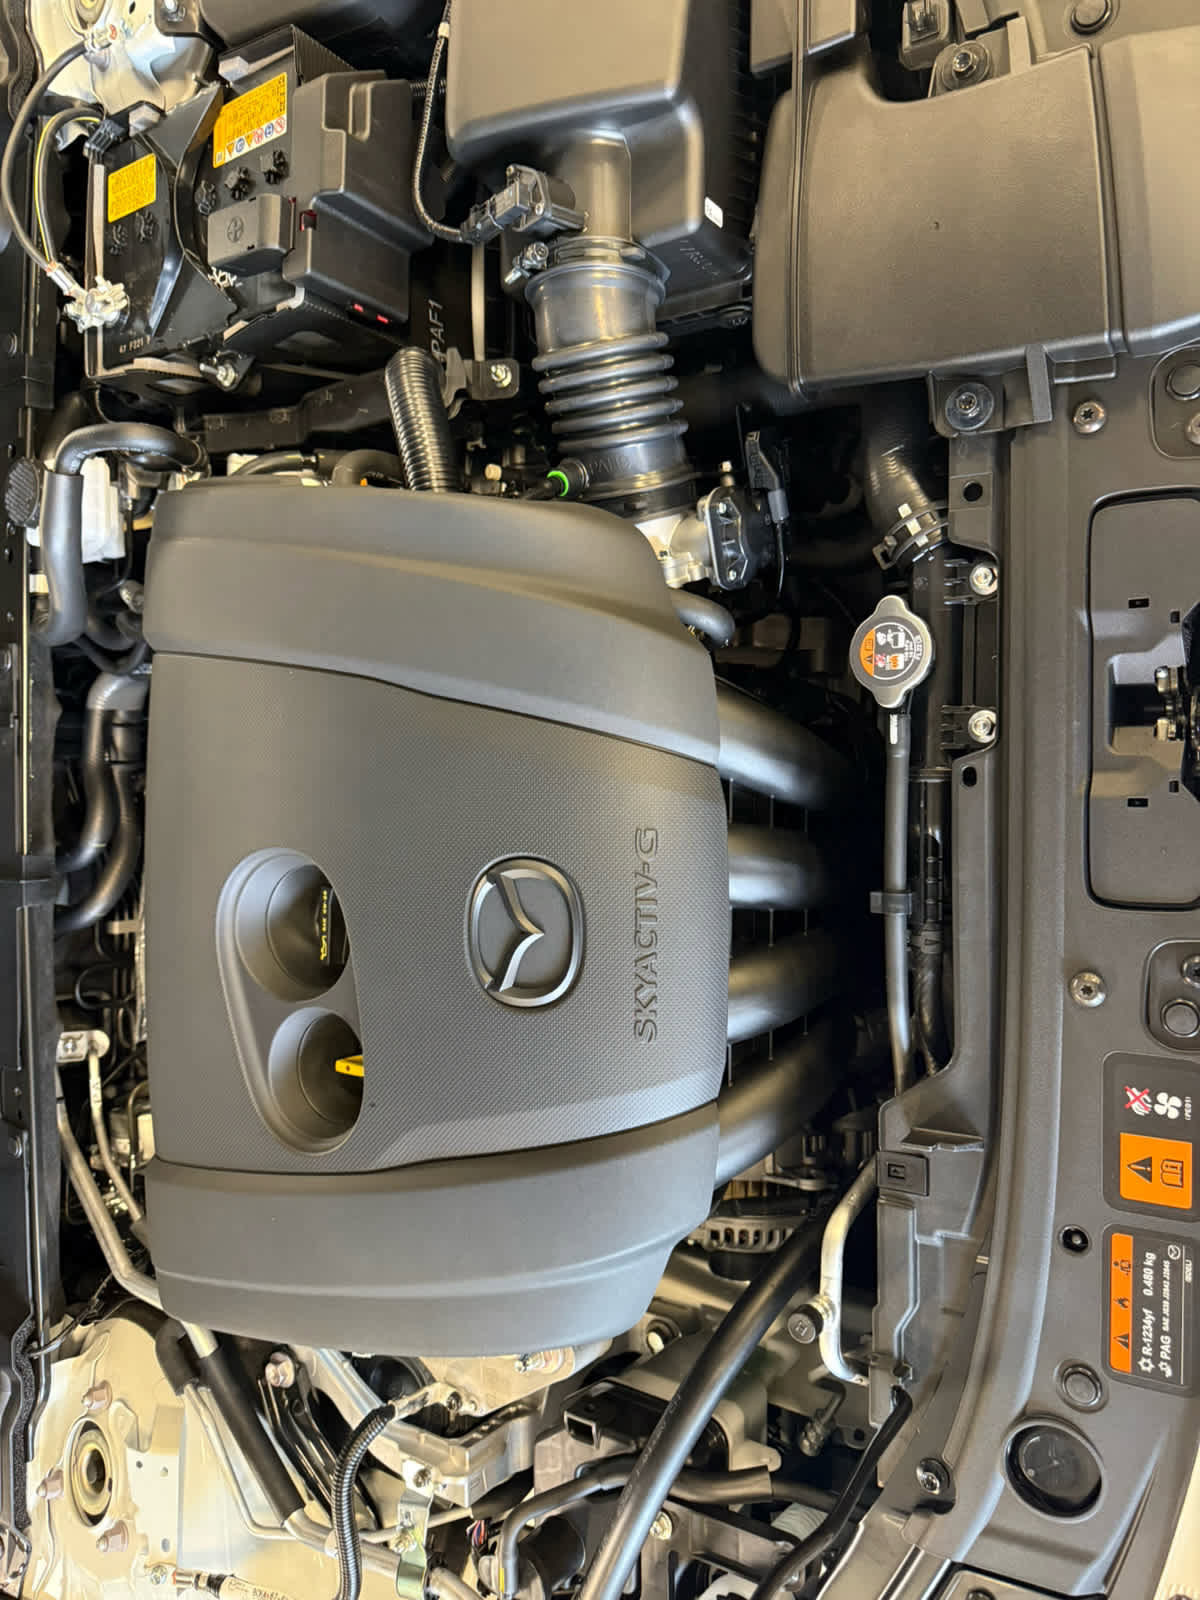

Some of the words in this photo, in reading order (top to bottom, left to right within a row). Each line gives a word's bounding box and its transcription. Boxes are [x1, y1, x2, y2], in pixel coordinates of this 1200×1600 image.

[633, 828, 659, 1042] SKYACTIV-G
[1143, 1251, 1157, 1267] kg
[1142, 1267, 1154, 1297] 0.480
[1141, 1308, 1156, 1356] R-1234yf
[1159, 1335, 1172, 1361] PAG
